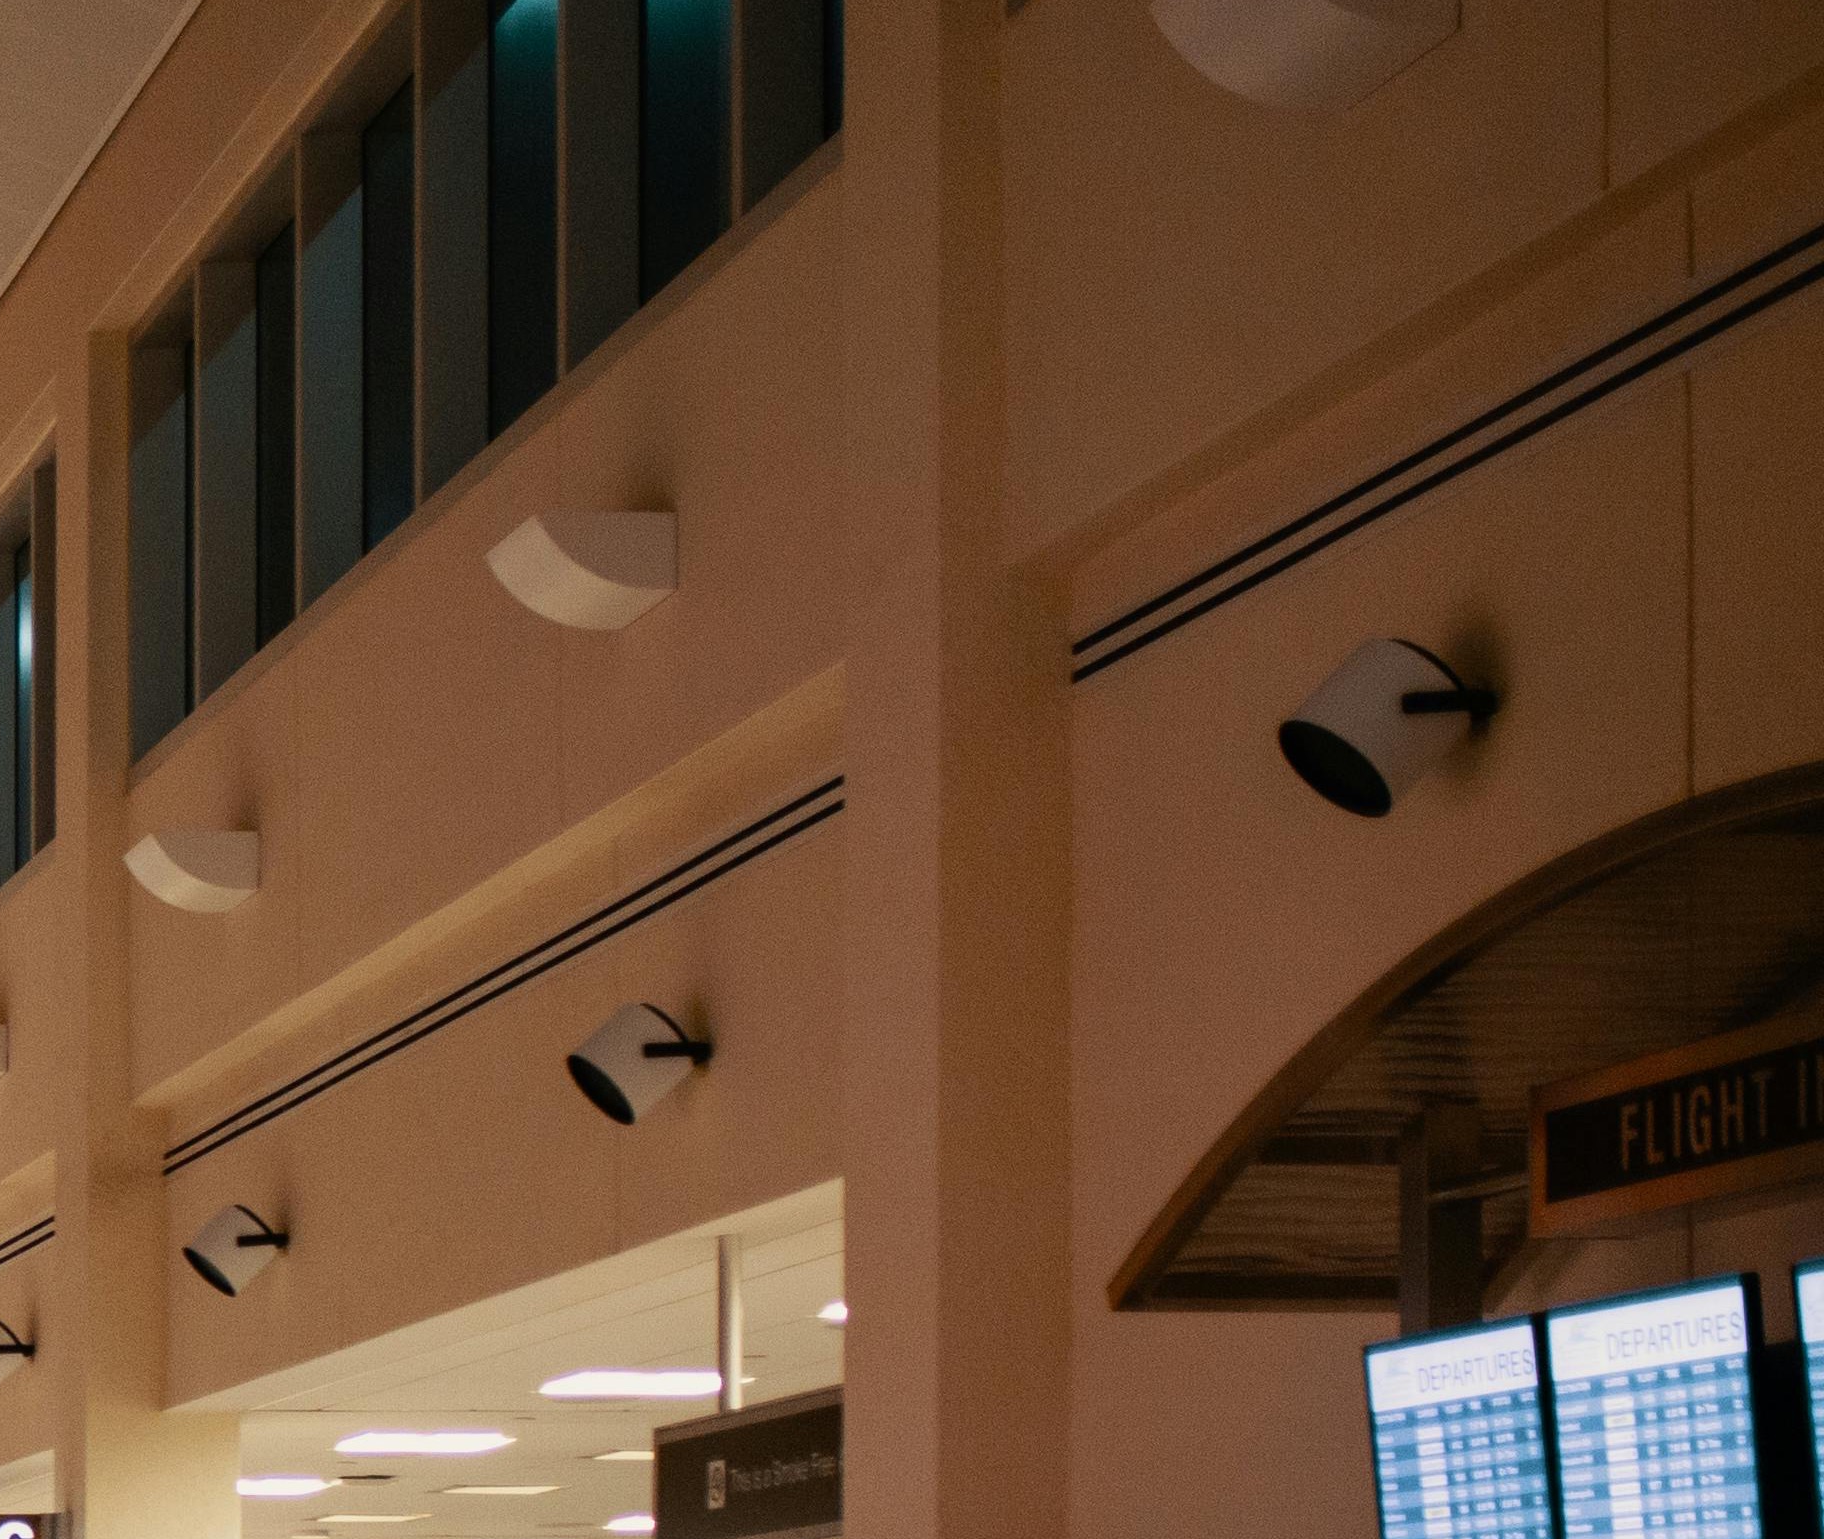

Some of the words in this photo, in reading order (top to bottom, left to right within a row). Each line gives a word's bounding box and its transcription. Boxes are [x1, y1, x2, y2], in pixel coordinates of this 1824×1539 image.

[1619, 1069, 1774, 1172] FLIGHT
[1606, 1310, 1744, 1361] DEPARTURES
[1417, 1348, 1536, 1393] DEPARTURES
